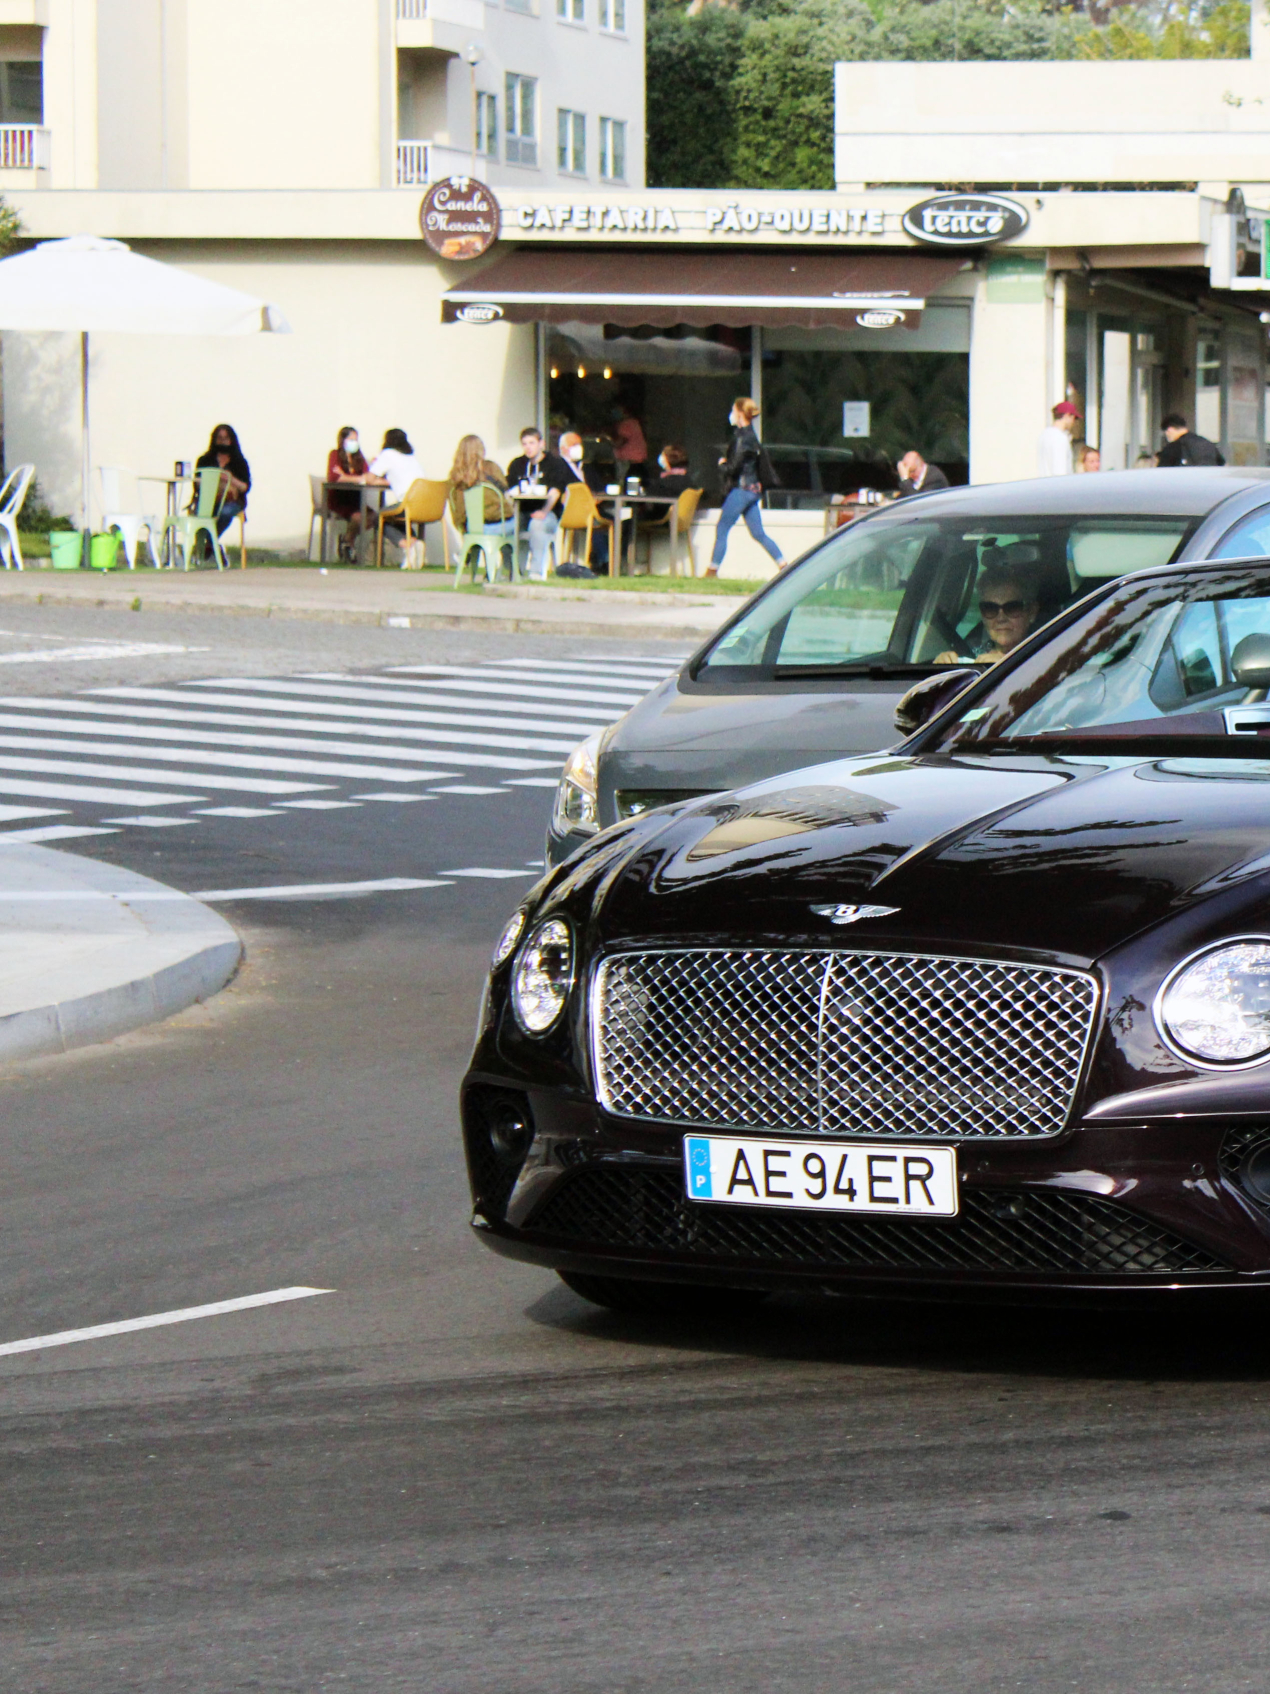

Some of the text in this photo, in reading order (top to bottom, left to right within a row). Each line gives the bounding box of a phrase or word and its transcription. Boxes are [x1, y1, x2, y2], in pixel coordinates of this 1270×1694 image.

[432, 187, 489, 211] Canela
[426, 210, 492, 232] Moscada
[516, 201, 884, 233] CAFETARIA PÃO-QUENTE
[696, 1175, 706, 1188] P
